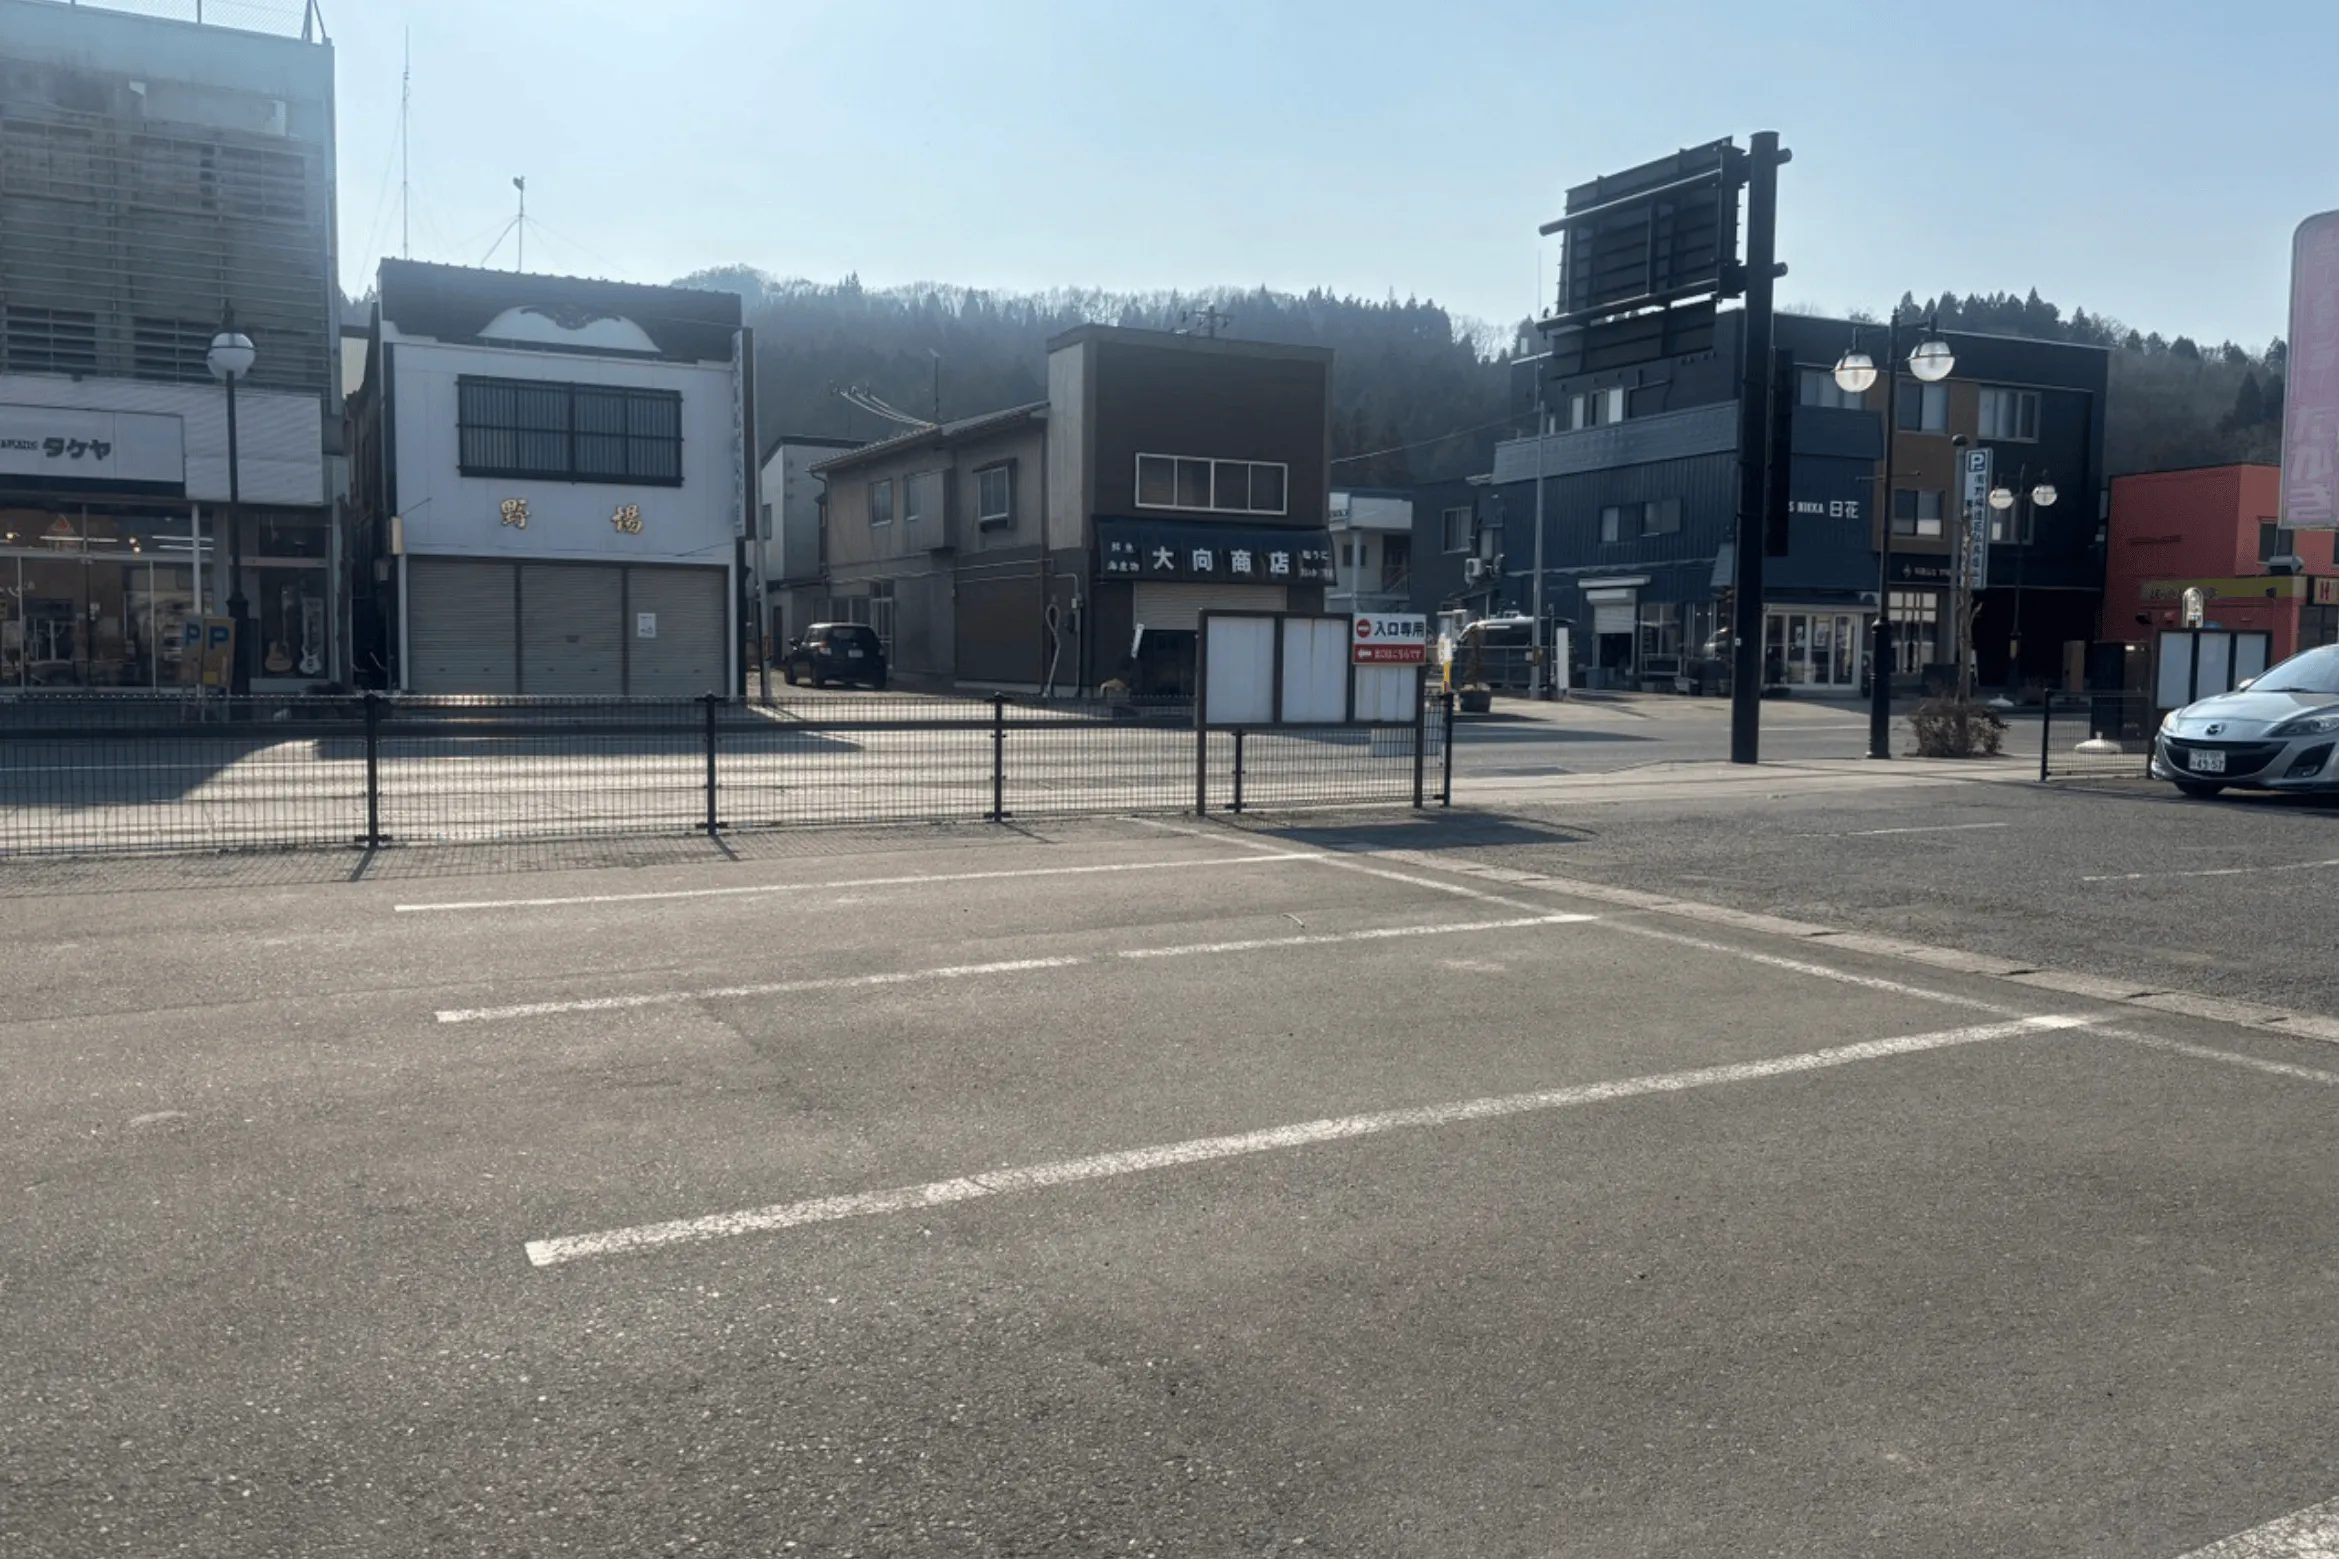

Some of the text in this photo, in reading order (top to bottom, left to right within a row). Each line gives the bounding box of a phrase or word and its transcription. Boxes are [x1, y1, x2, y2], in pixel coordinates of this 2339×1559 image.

[43, 437, 111, 460] タケヤ
[1970, 453, 1984, 471] P
[1797, 501, 1824, 513] NIKKA
[1829, 501, 1859, 518] 日花
[1152, 546, 1290, 575] 大向商店
[186, 624, 200, 645] P
[209, 626, 230, 649] P
[1374, 620, 1424, 638] 入口専用
